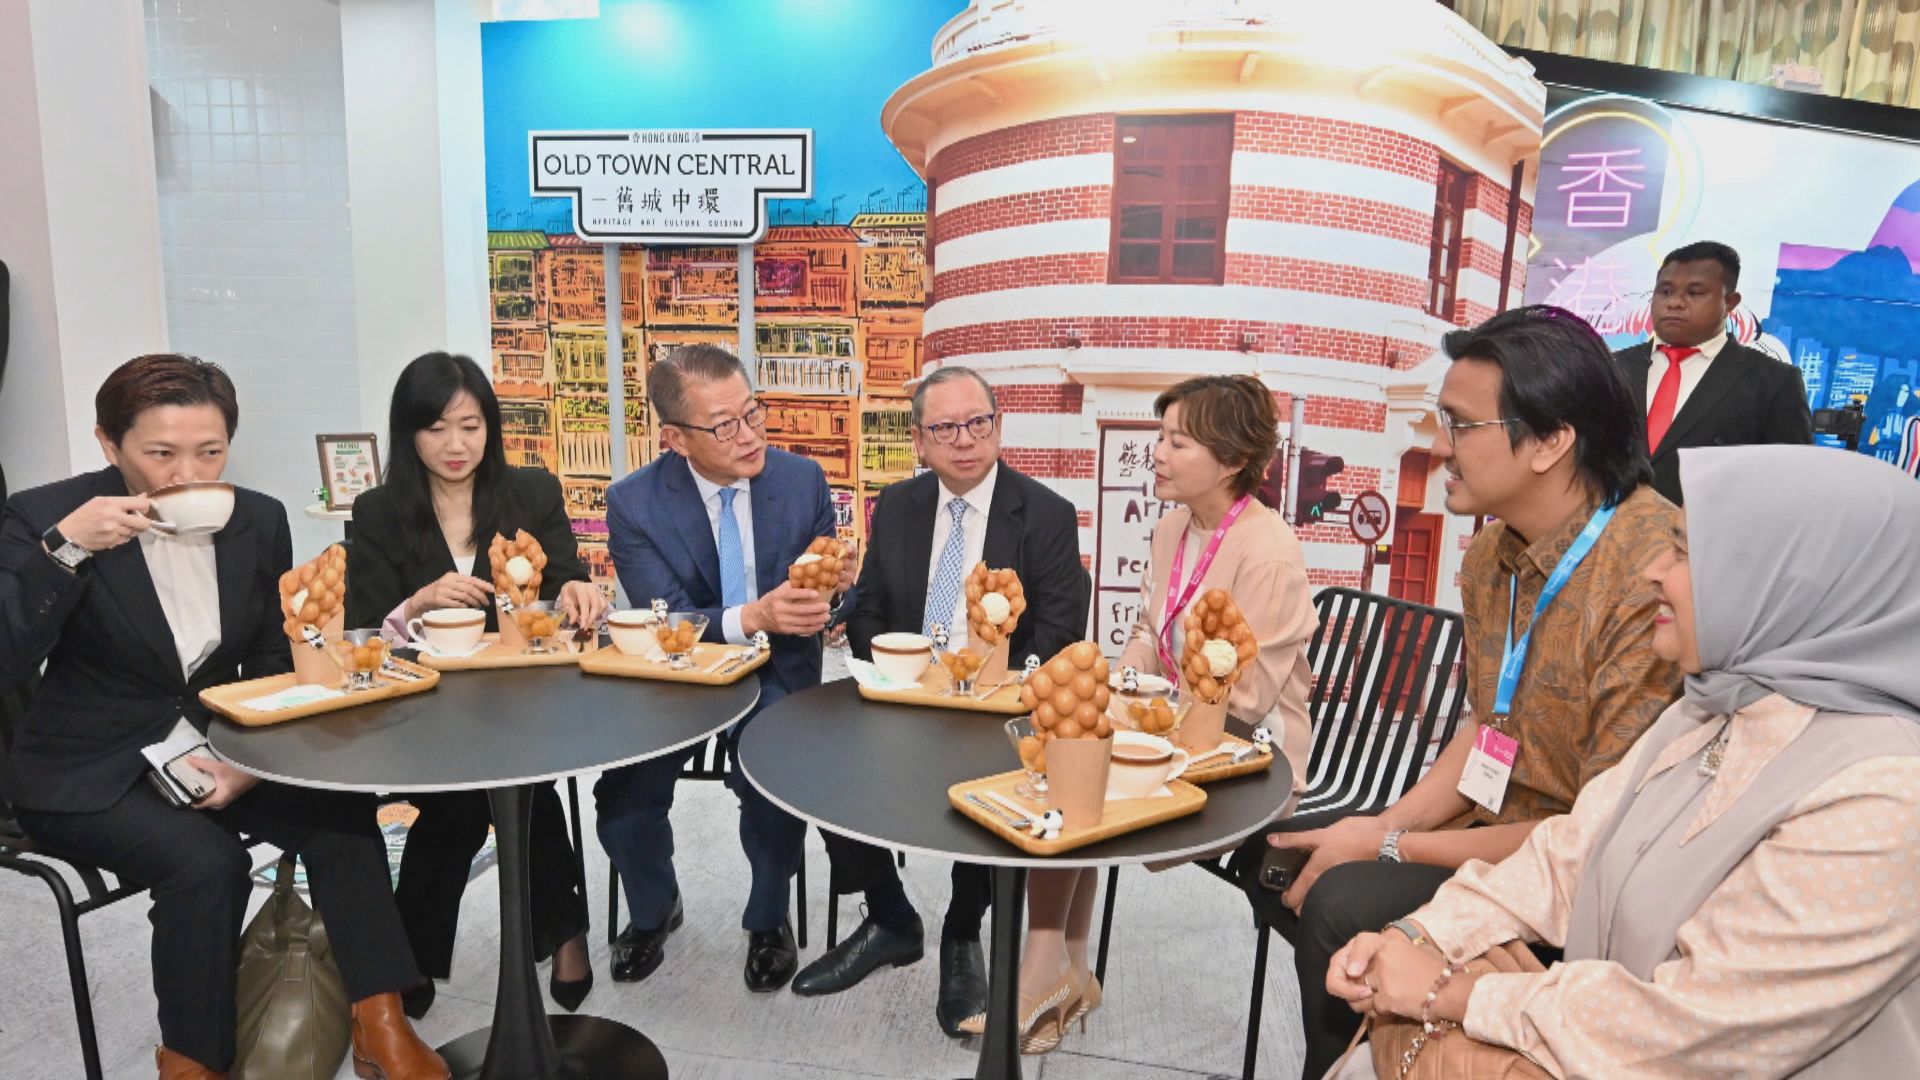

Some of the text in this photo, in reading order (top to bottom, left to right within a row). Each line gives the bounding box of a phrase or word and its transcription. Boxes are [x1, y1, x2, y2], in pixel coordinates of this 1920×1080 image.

[642, 132, 689, 143] HONG KONG
[543, 154, 795, 176] OLD TOWN CENTRAL
[616, 186, 720, 214] 舊城中環
[592, 218, 744, 228] HERITAGE ART CULTURE CUISINE
